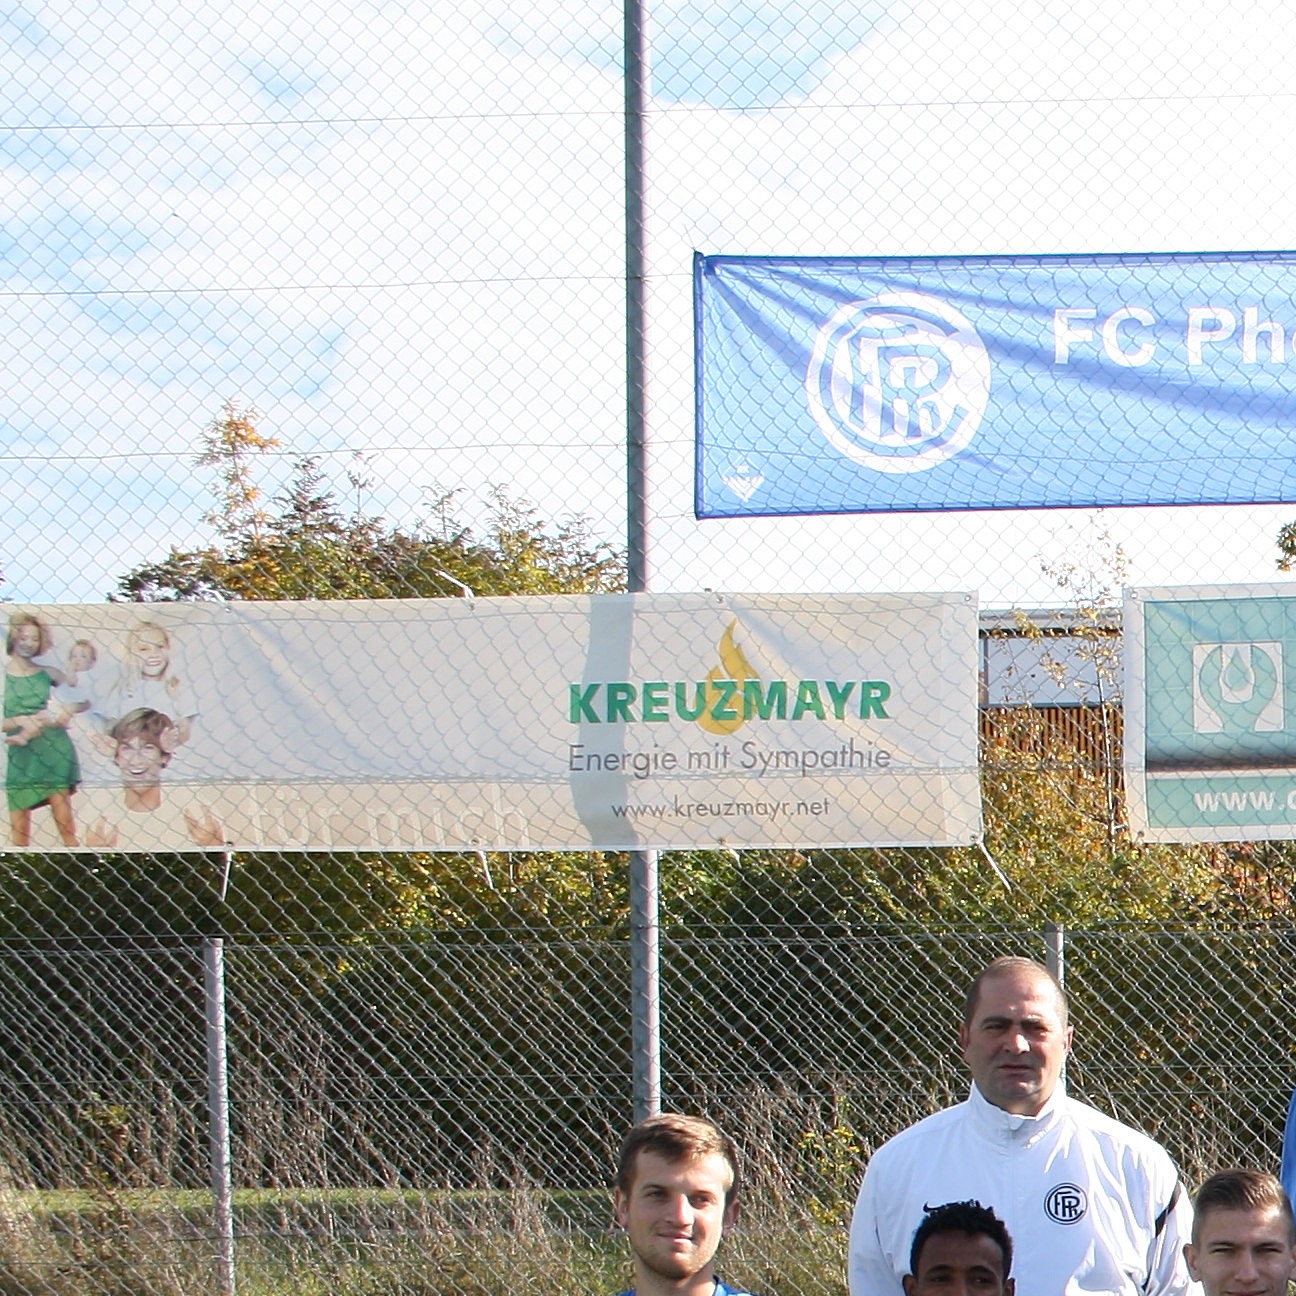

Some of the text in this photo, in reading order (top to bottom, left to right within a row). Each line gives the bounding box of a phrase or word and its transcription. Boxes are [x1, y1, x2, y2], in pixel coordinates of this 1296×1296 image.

[1052, 306, 1157, 366] FC
[569, 680, 892, 724] KREUZMAYR
[569, 737, 891, 779] Energie mit Sympathie
[612, 795, 830, 823] www.kreuzmayr.net
